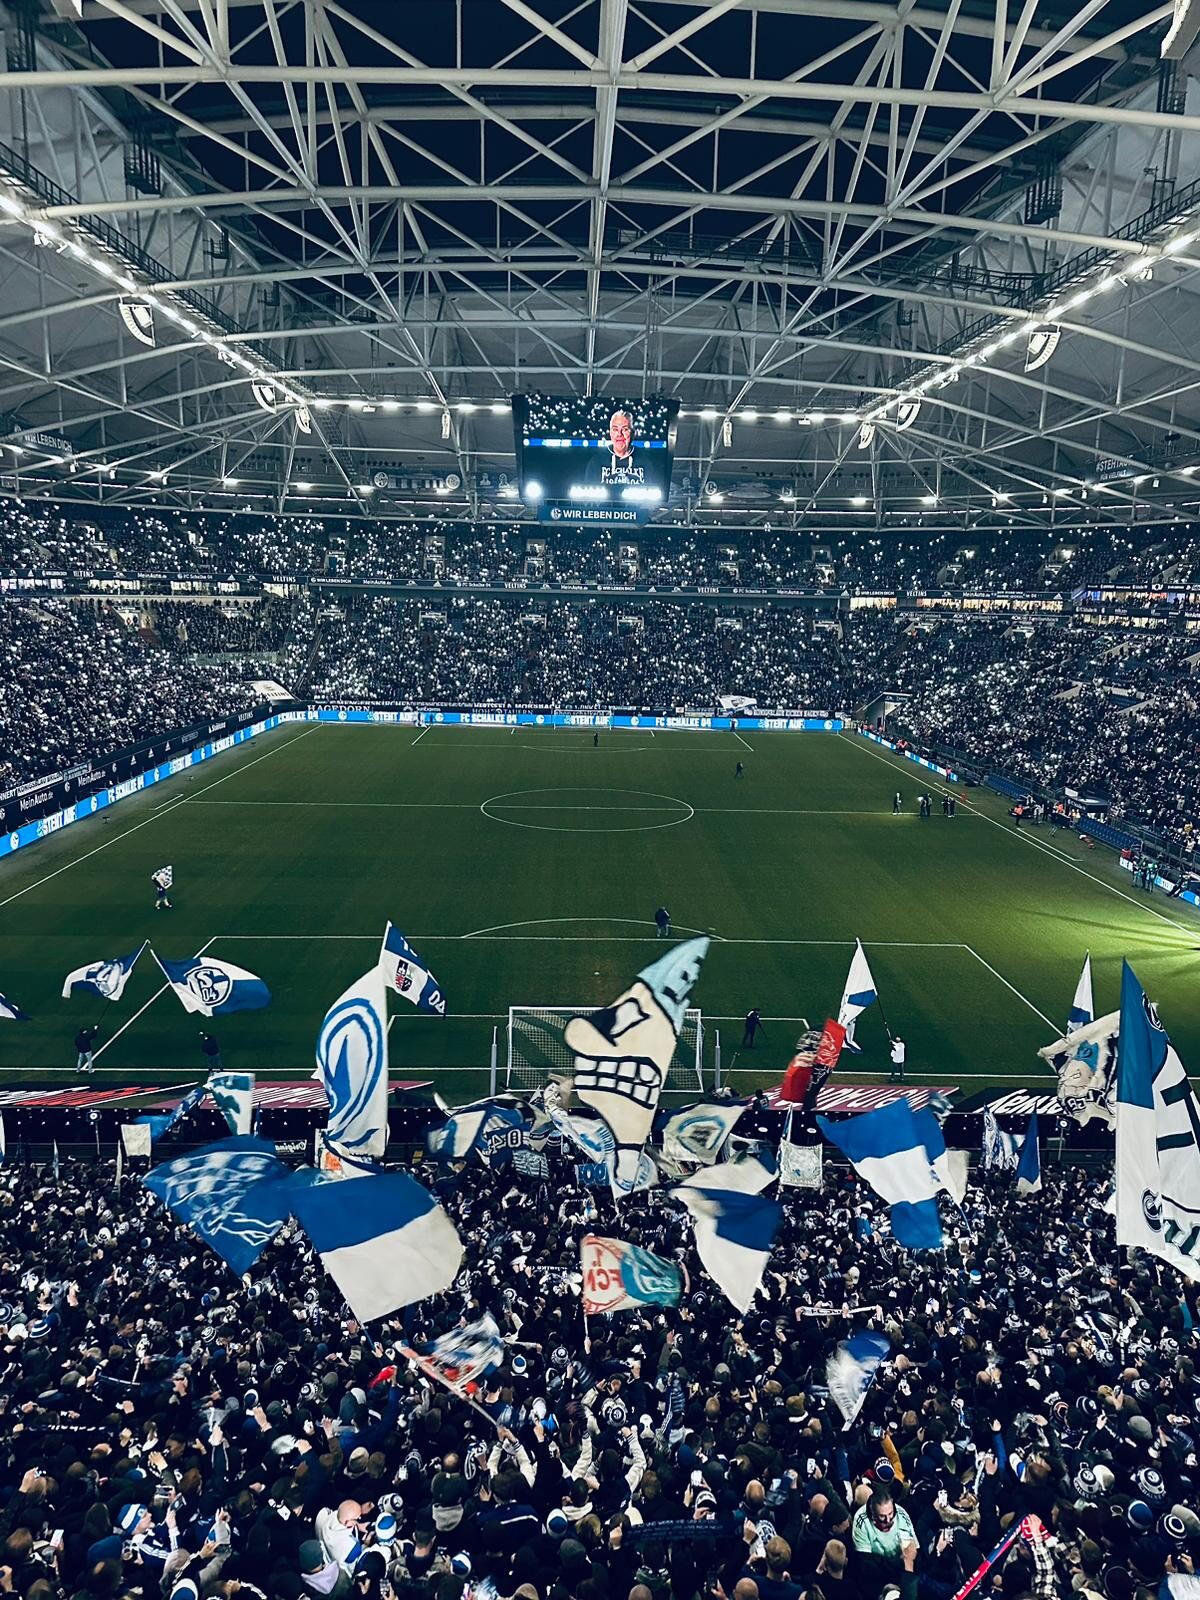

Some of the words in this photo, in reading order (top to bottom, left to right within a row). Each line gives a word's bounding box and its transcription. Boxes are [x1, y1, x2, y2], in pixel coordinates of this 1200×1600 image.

[37, 433, 57, 448] LEBEN
[57, 437, 72, 452] DICH
[563, 511, 581, 519] WIR
[582, 511, 613, 519] LEBEN
[613, 511, 637, 520] DICH
[272, 575, 296, 583] VELTINS
[238, 710, 253, 722] VELTINS
[461, 714, 470, 723] FC
[471, 714, 505, 723] SCHALKE
[506, 714, 518, 724] 04
[655, 718, 665, 727] FC
[666, 718, 700, 727] SCHALKE
[701, 718, 711, 728] 04
[20, 791, 53, 811] MeinAuto.de
[428, 990, 446, 1014] 04
